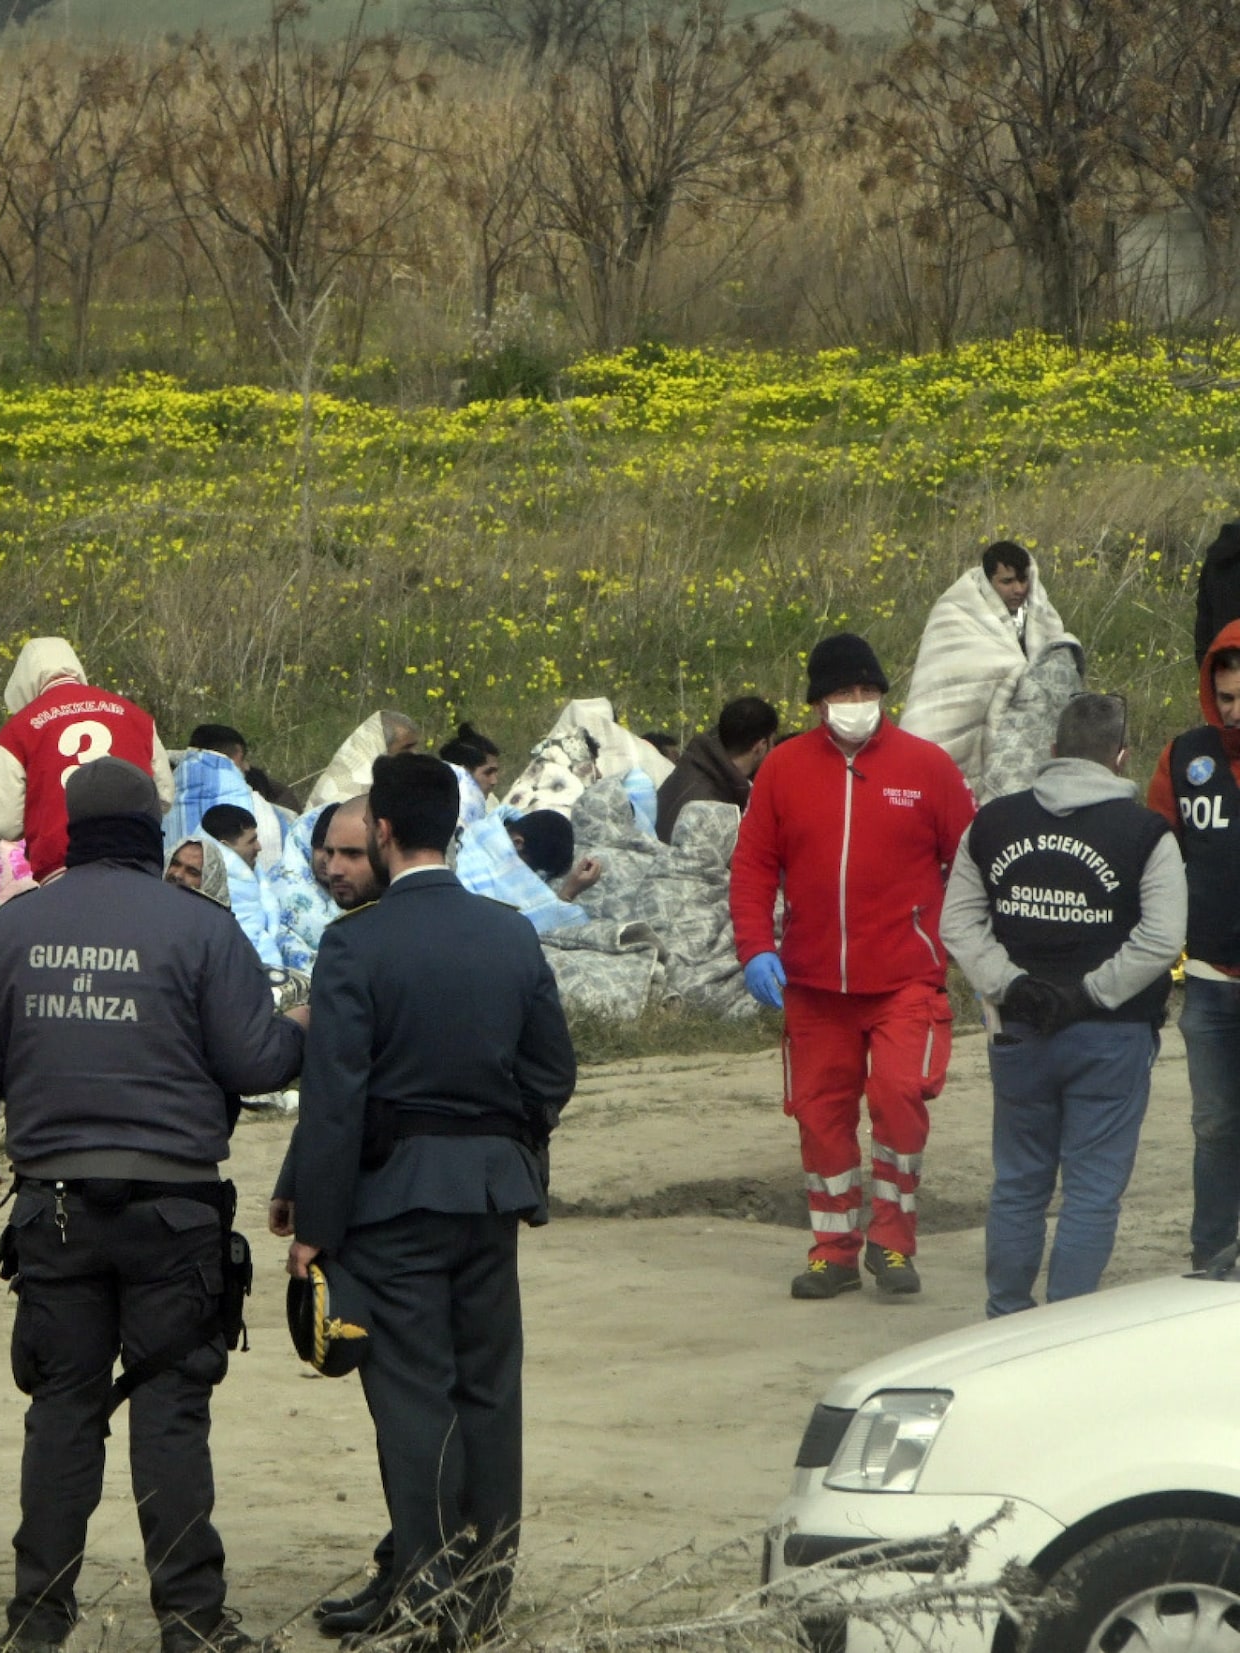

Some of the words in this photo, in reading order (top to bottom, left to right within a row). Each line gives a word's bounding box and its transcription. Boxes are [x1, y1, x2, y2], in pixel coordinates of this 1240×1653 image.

[1179, 795, 1230, 830] POL
[989, 837, 1034, 885] POLIZIA
[1037, 834, 1121, 893] SCIENTIFICA
[1011, 885, 1088, 907] SQUADRA
[996, 898, 1113, 923] SOPRALLUOGHI
[29, 945, 140, 972] GUARDIA
[73, 973, 92, 992] di
[25, 994, 138, 1022] FINANZA
